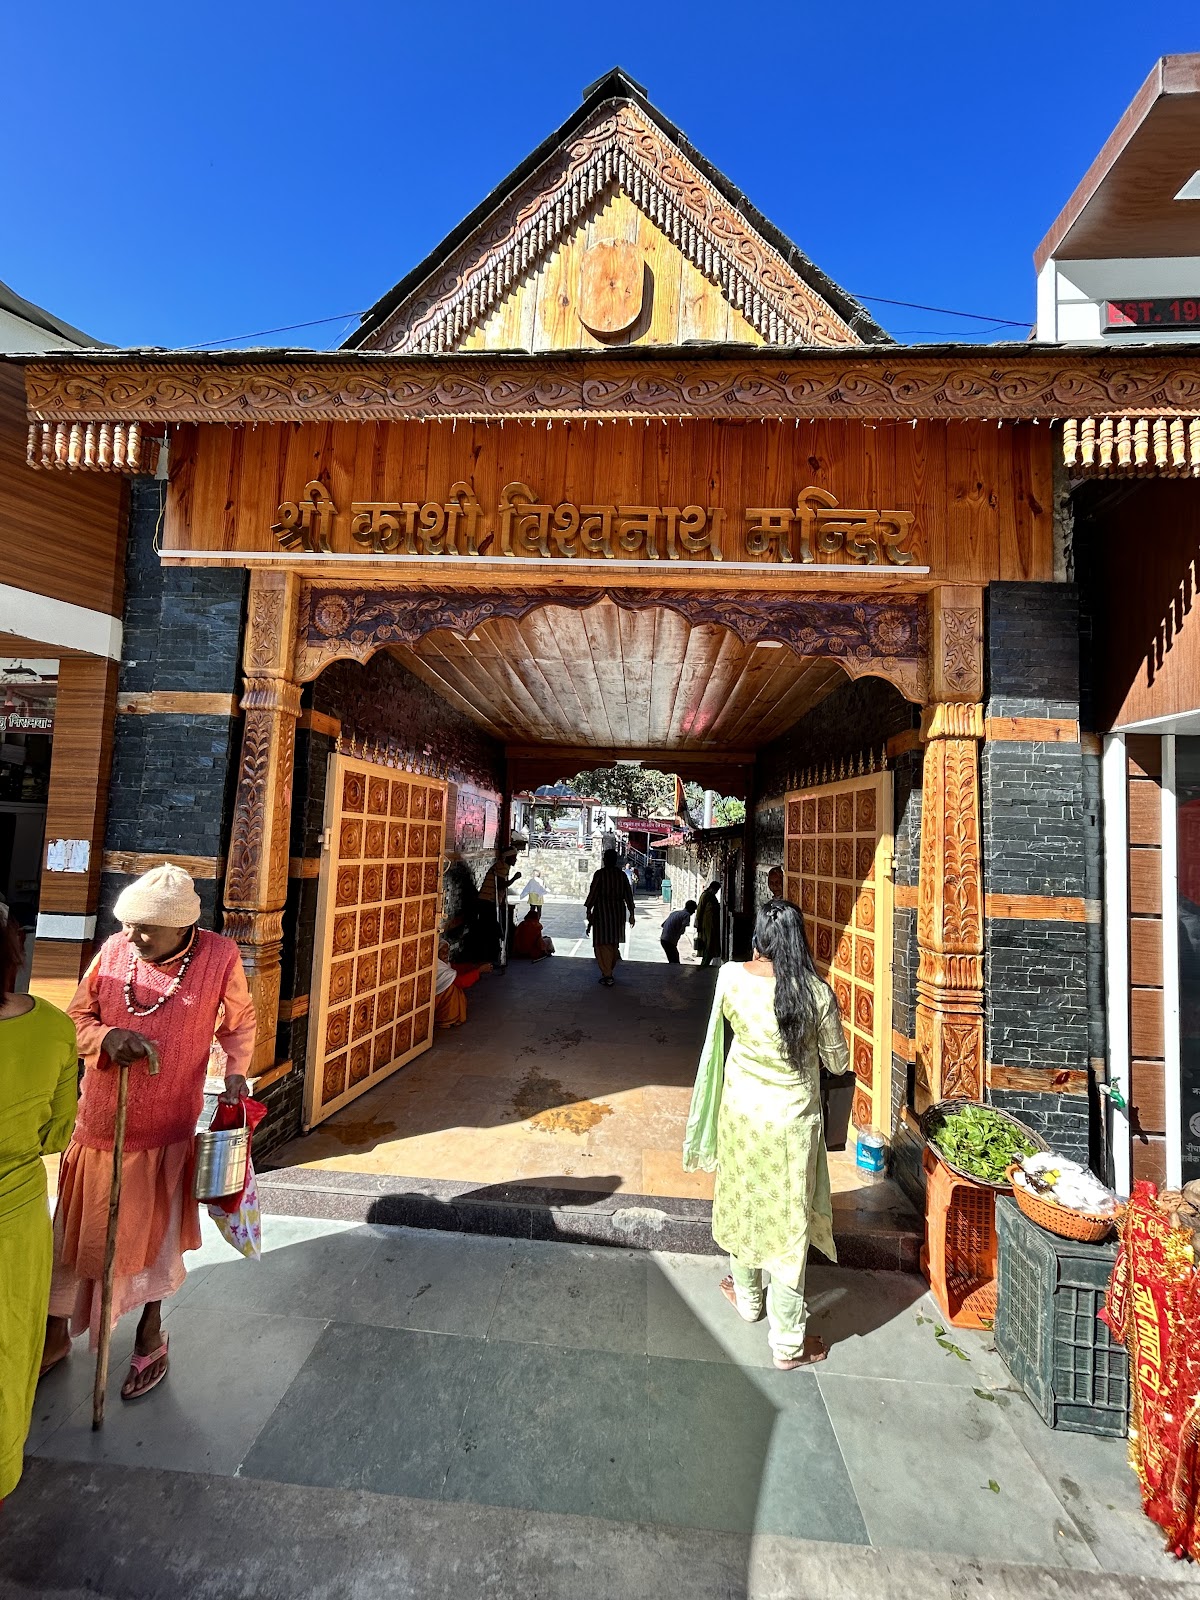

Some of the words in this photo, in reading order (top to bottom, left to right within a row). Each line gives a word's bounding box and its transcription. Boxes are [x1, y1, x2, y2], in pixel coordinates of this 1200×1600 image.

[1108, 302, 1161, 323] EST.
[1170, 299, 1200, 321] 19
[270, 480, 338, 555] श्री
[351, 481, 479, 557] काशी
[498, 481, 727, 561] विश्वनाथ
[745, 486, 915, 565] मन्दिर
[1131, 1282, 1159, 1322] जय
[1137, 1319, 1162, 1371] माता
